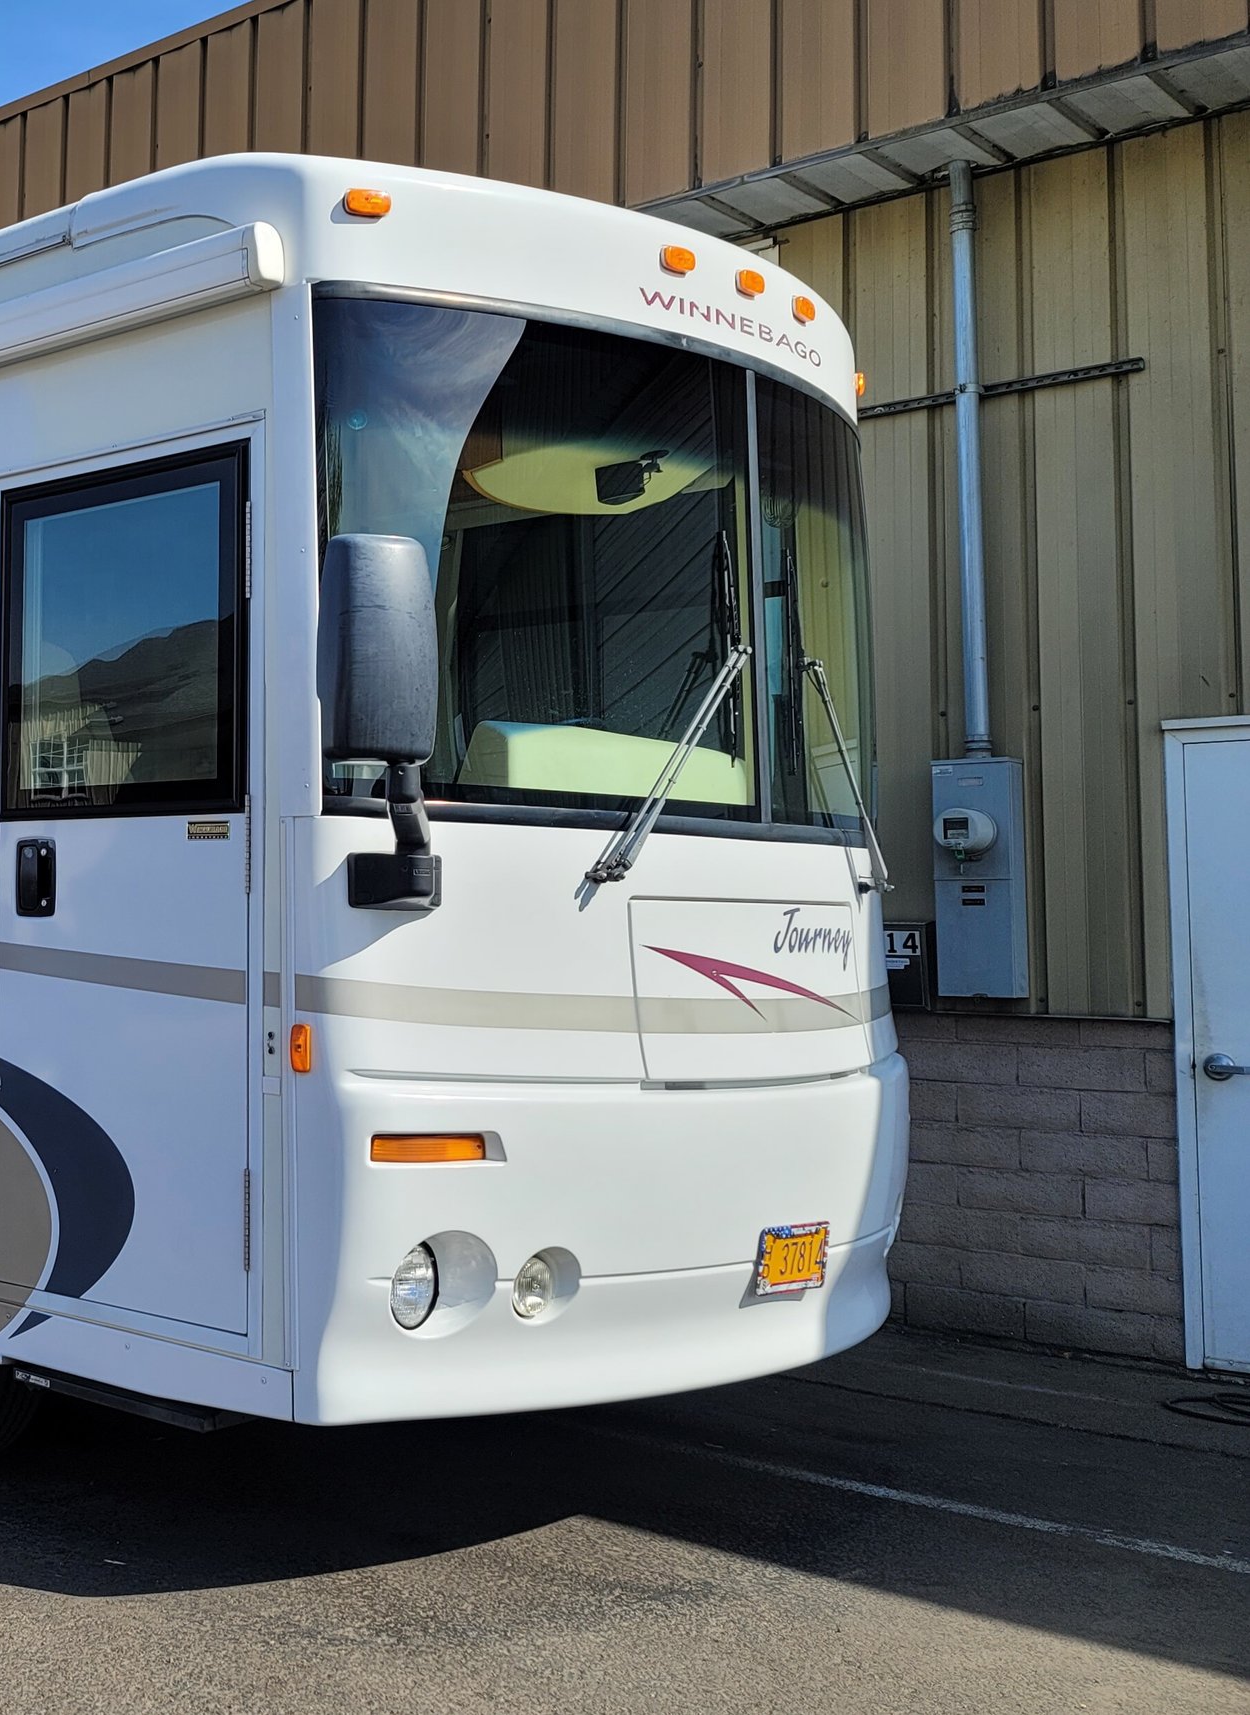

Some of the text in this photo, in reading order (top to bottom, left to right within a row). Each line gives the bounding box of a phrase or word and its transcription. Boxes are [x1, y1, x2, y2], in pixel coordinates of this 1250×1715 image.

[639, 287, 822, 367] WINNEBAGO
[773, 907, 853, 972] Journey
[886, 932, 919, 954] 14
